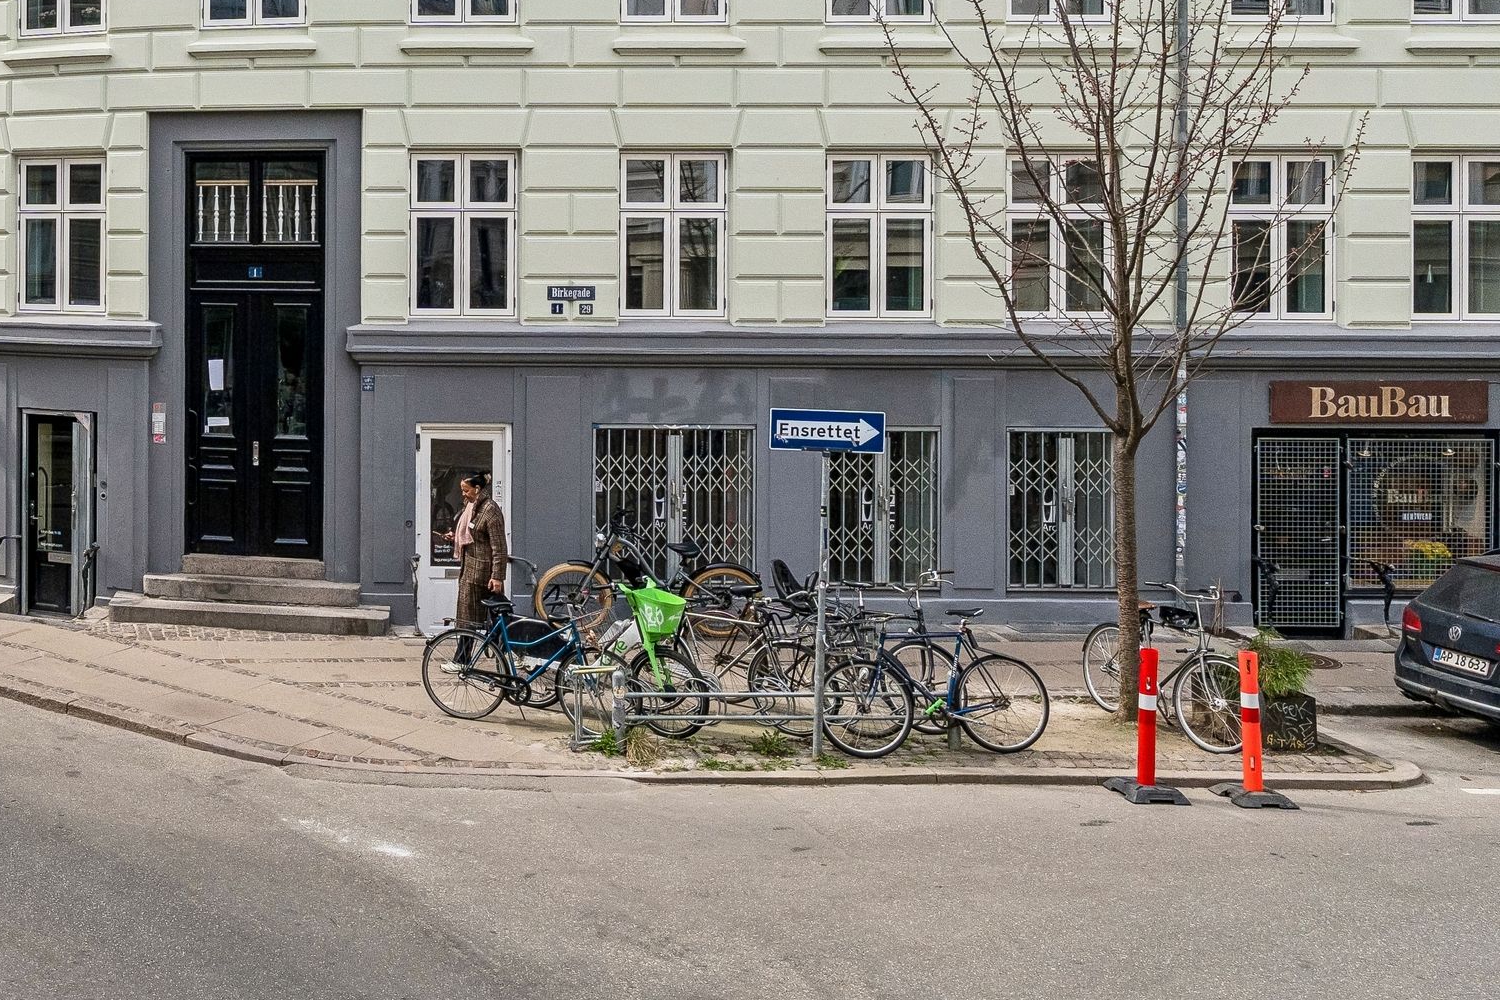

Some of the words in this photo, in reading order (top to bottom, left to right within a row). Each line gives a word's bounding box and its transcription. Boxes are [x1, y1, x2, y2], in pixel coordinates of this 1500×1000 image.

[552, 288, 591, 300] Birkegade
[581, 305, 591, 313] 29
[1308, 386, 1453, 418] BauBau
[780, 423, 860, 439] Ensrettet
[1440, 650, 1453, 662] AP
[1455, 654, 1466, 667] 18
[1467, 660, 1487, 673] 632
